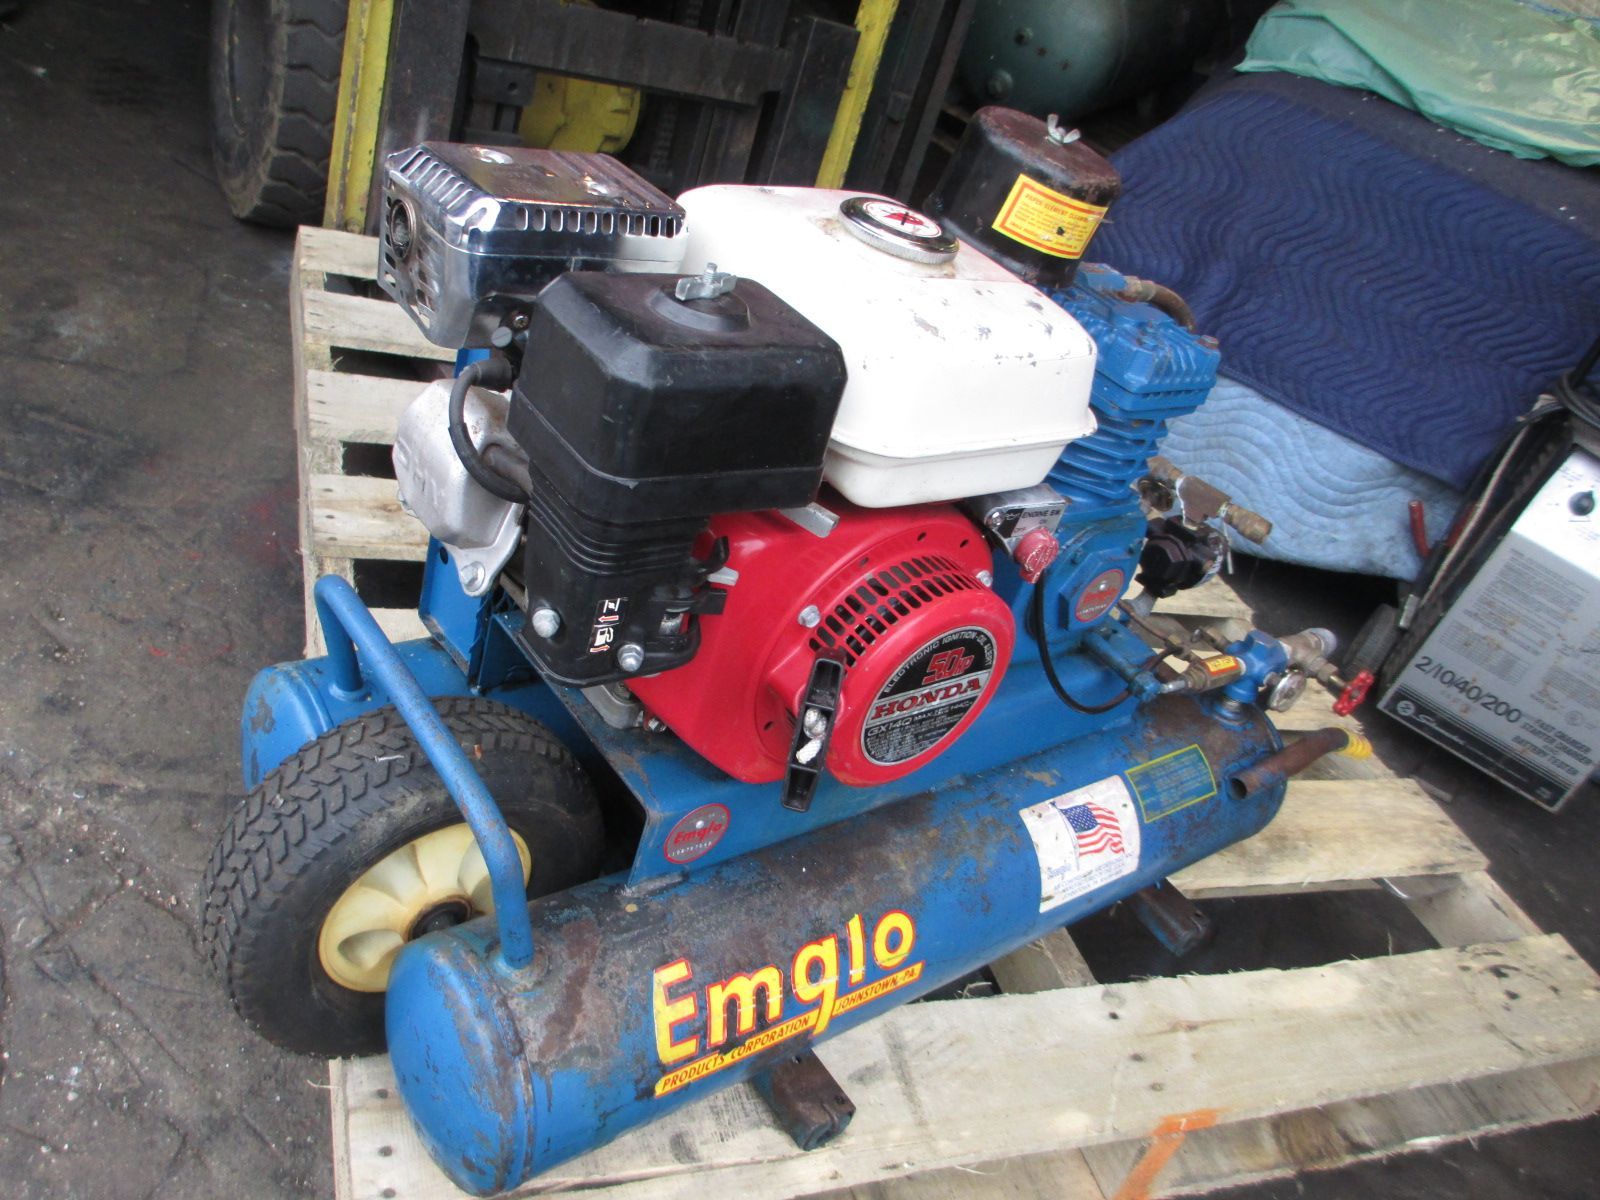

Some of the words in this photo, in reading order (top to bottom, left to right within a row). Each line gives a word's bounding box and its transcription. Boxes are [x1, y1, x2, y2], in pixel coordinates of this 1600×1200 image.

[871, 677, 981, 720] HONDA
[1415, 656, 1522, 723] 2/10/40/200
[867, 717, 912, 736] GX140
[653, 909, 915, 1065] Emglo
[662, 1053, 725, 1091] PRODUCTS
[730, 1015, 809, 1060] CORPORATION
